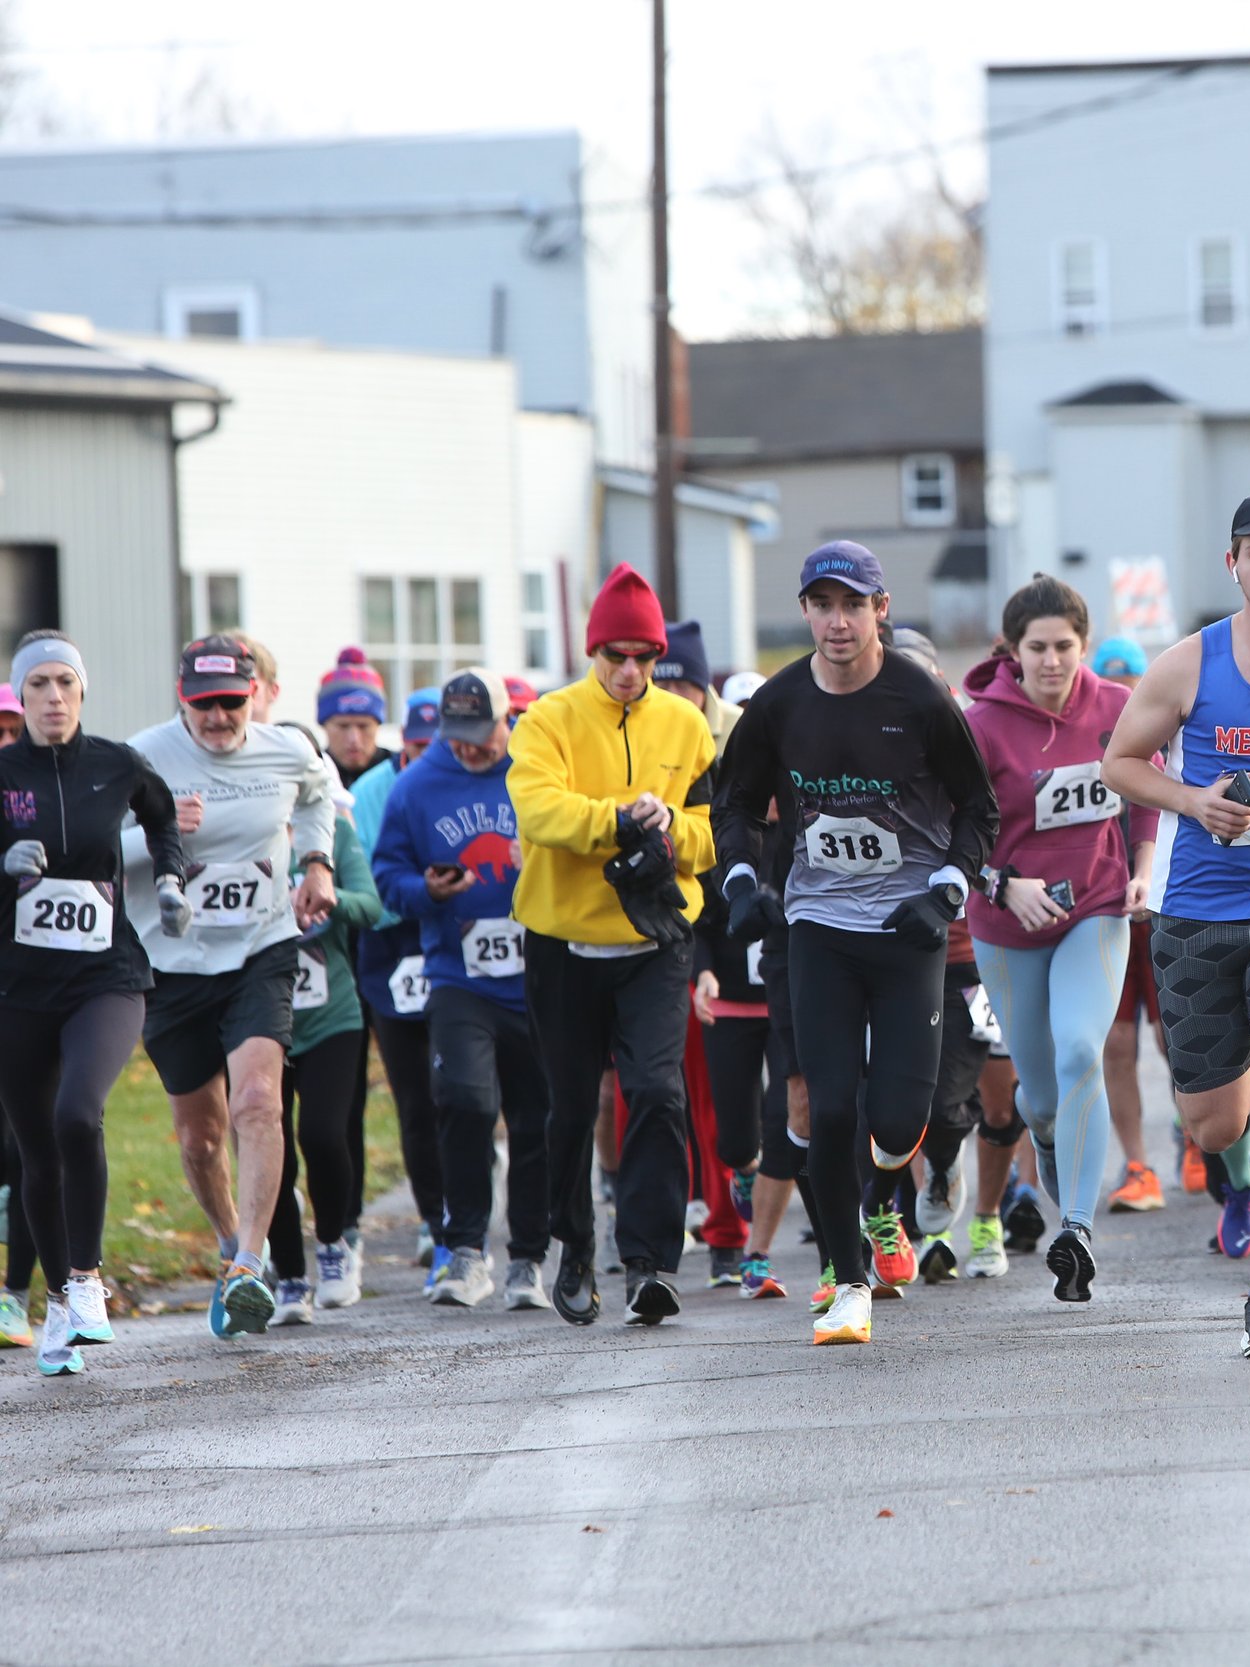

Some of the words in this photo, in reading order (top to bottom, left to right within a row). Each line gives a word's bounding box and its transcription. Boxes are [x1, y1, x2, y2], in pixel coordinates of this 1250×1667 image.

[815, 559, 830, 574] RUN
[831, 559, 855, 573] HAPPY
[1052, 779, 1107, 815] 216
[434, 802, 518, 847] BILL
[819, 832, 883, 861] 318
[202, 879, 259, 910] 267
[33, 899, 97, 933] 280
[476, 934, 524, 961] 251
